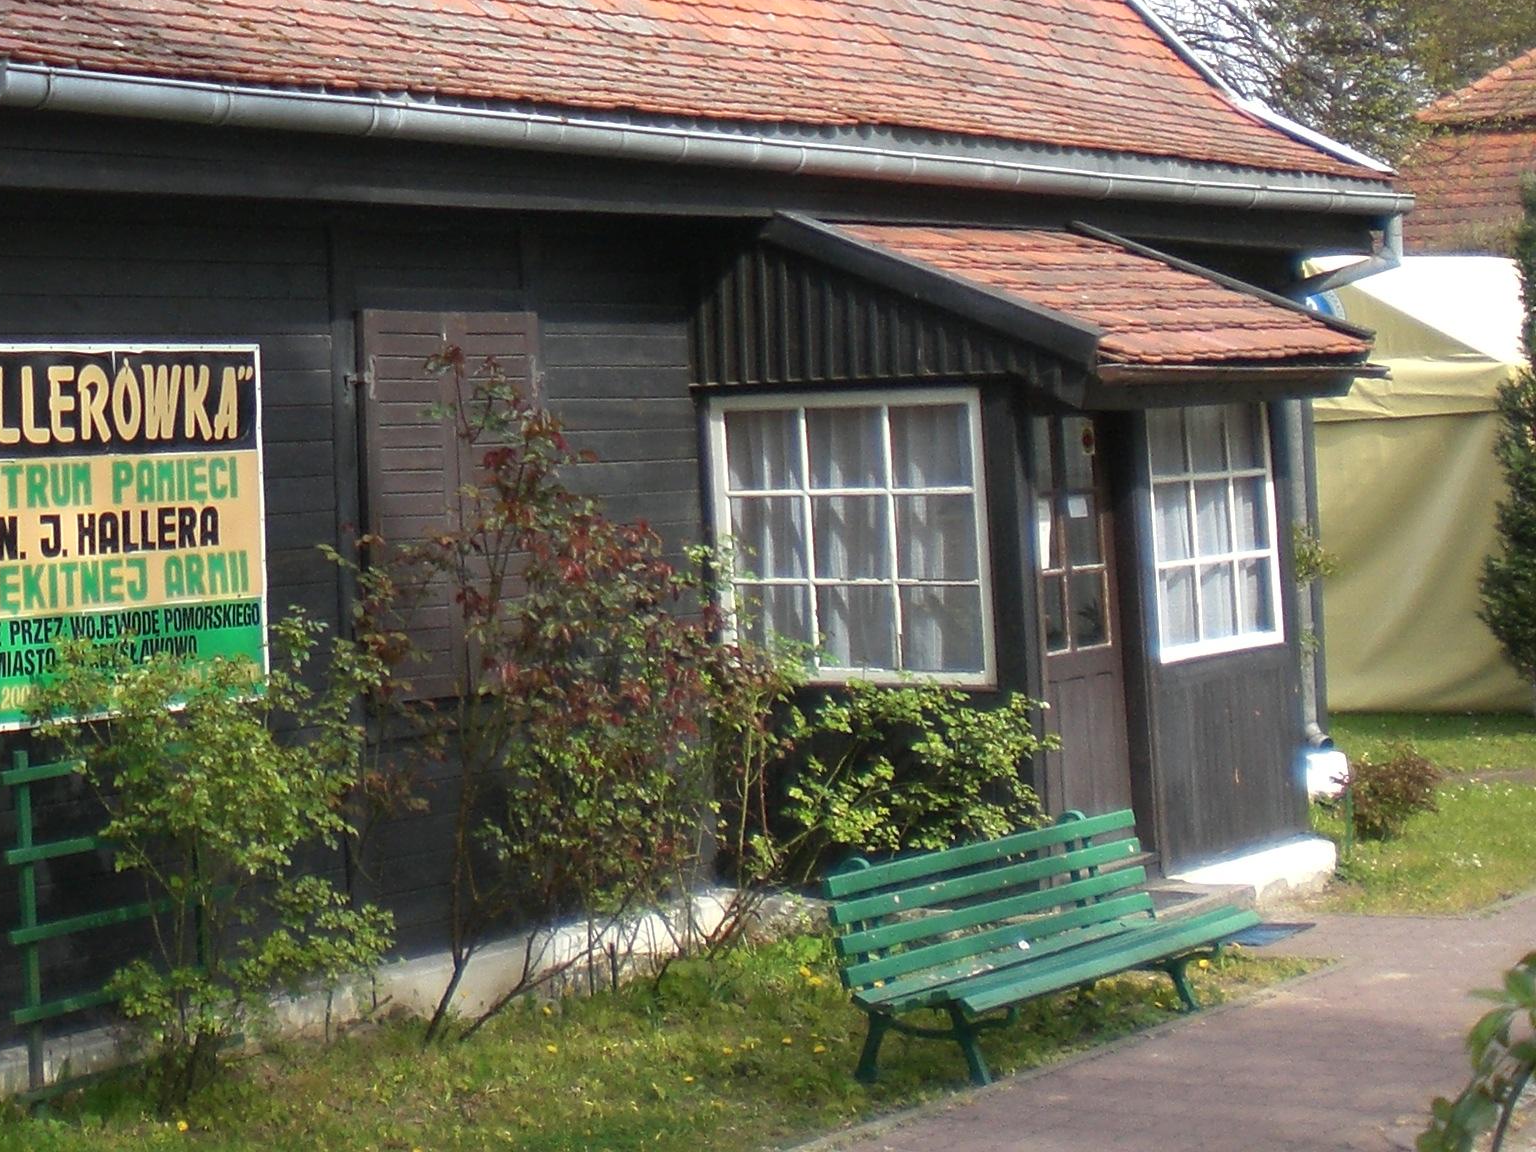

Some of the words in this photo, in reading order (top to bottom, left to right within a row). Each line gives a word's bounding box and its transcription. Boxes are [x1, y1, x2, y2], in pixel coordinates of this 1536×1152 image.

[113, 456, 239, 505] PAMIĘCI
[40, 514, 69, 558] J.
[76, 506, 220, 557] HALLERA
[164, 550, 250, 599] ARMII
[70, 608, 160, 641] WOJEWODĘ
[164, 602, 261, 632] POMORSKIEGO
